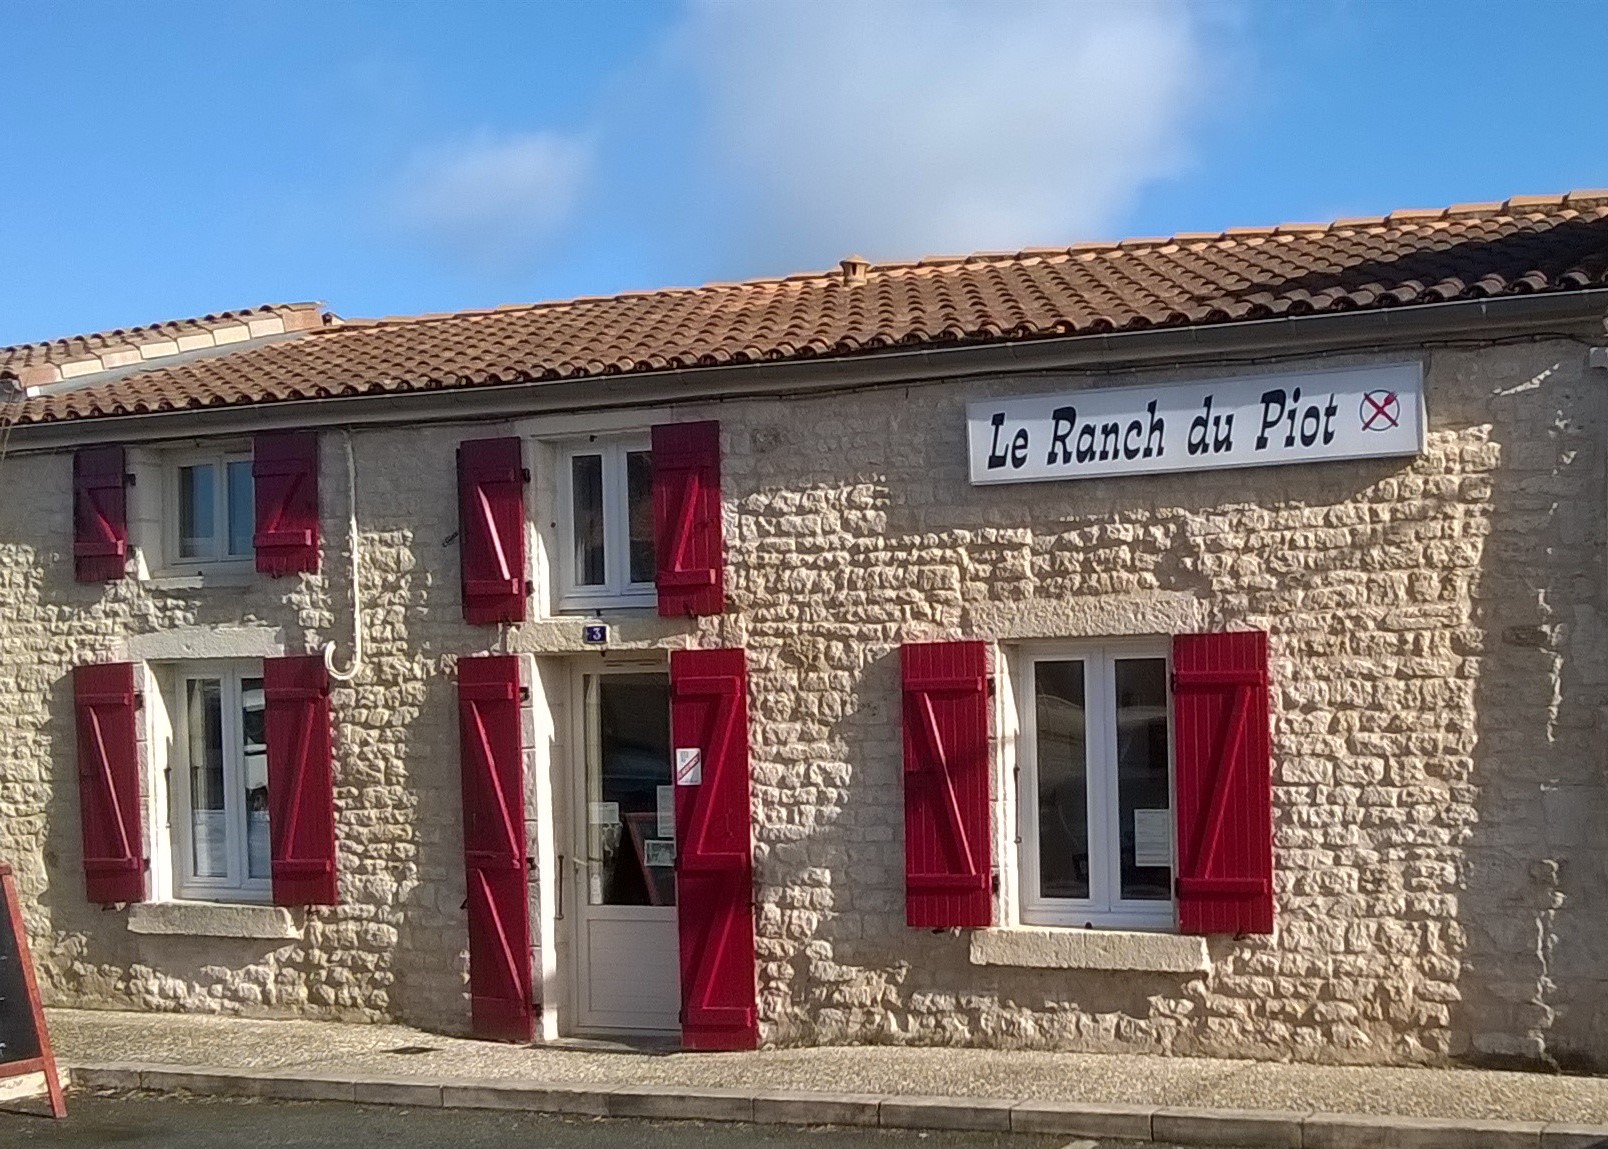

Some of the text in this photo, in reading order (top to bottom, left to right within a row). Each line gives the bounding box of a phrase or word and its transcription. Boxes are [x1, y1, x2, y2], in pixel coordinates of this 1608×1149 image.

[987, 386, 1338, 469] Le Ranch du Piot
[592, 627, 602, 641] 3
